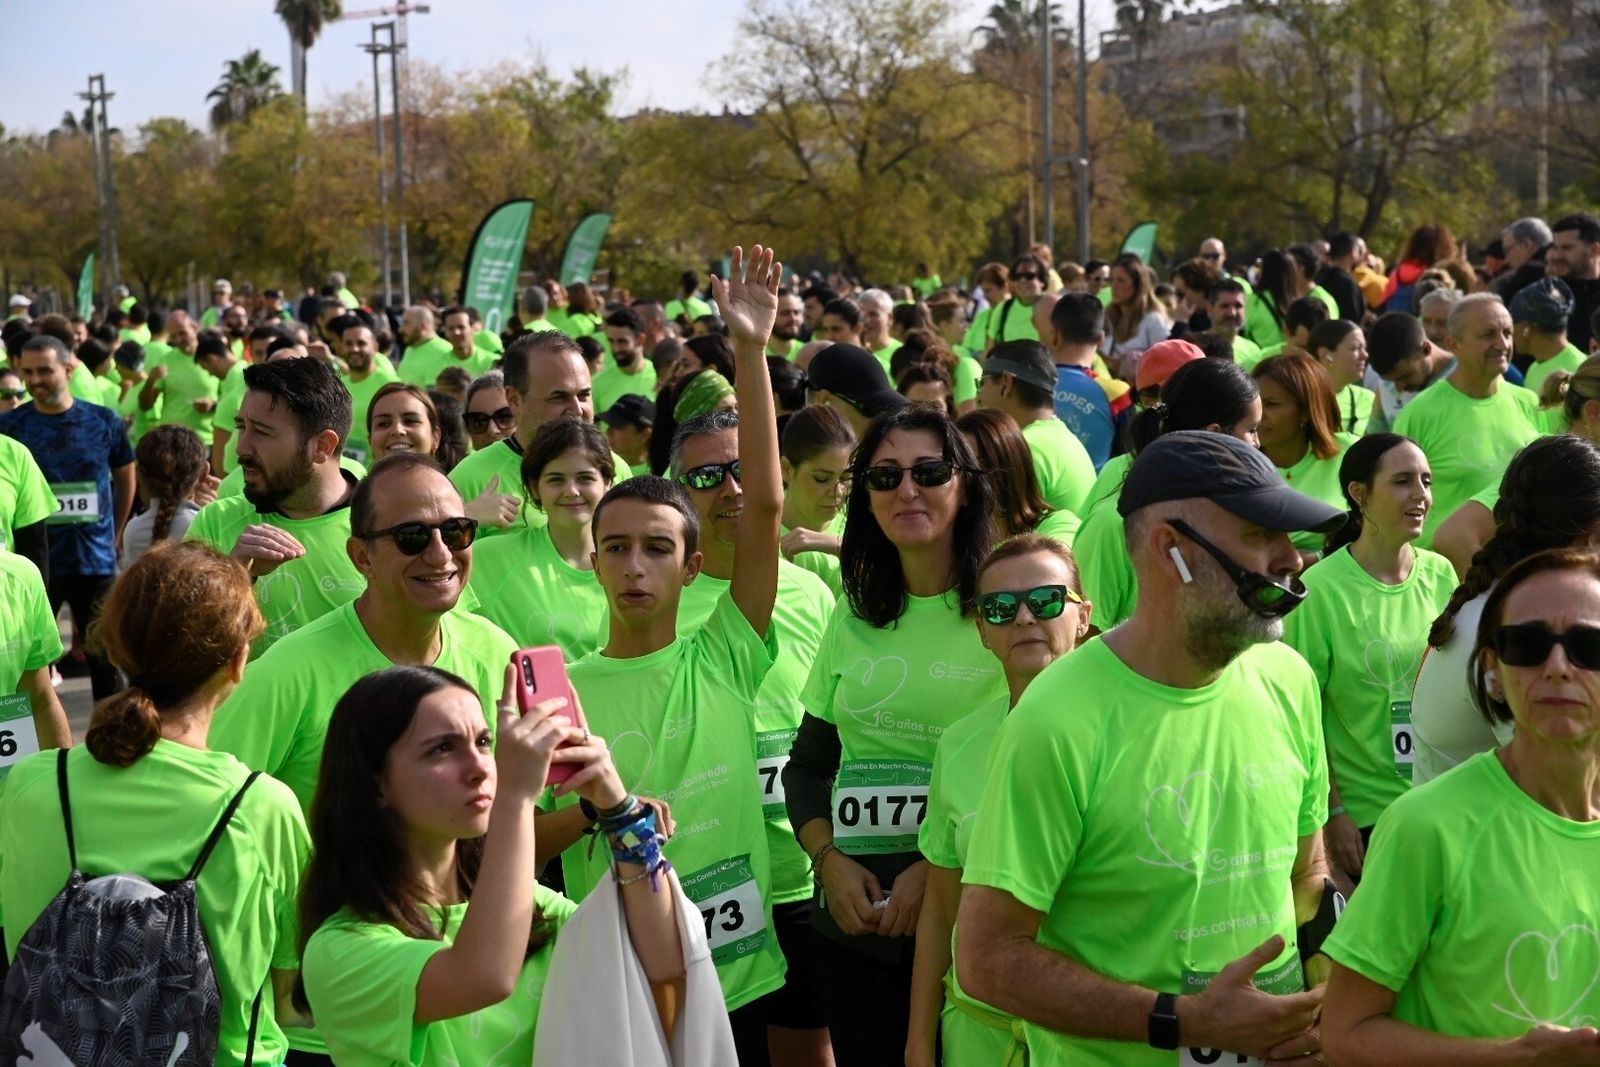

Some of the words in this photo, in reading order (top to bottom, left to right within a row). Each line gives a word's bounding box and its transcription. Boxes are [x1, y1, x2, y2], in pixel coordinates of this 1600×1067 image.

[1053, 391, 1095, 415] ORES
[896, 718, 925, 733] años
[759, 766, 778, 794] 7
[838, 796, 928, 827] 0177
